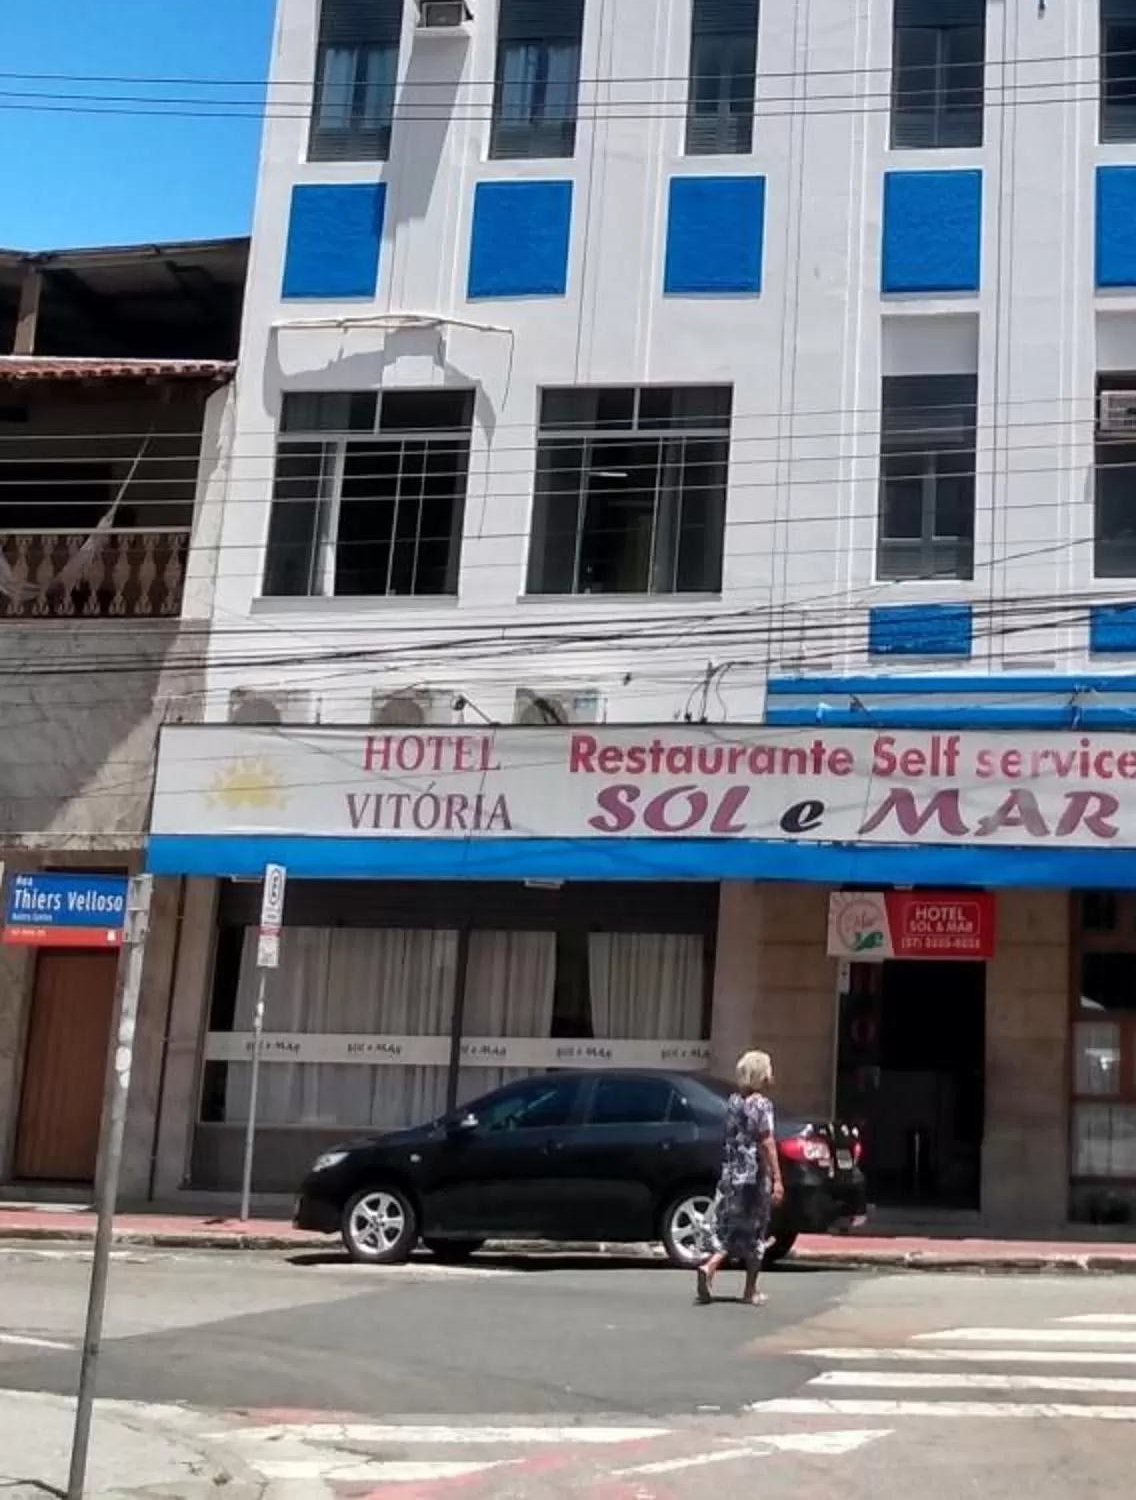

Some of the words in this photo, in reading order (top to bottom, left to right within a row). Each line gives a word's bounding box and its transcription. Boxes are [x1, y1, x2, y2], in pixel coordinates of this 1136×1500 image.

[363, 735, 502, 771] HOTEL
[569, 734, 853, 775] Restaurante
[872, 735, 960, 777] Self
[346, 780, 513, 830] VITÓRIA
[587, 784, 750, 833] SOL
[780, 800, 824, 834] e
[858, 787, 1119, 838] MAR
[14, 887, 61, 910] Thiers
[67, 889, 124, 912] Velloso
[915, 906, 966, 920] HOTEL
[909, 920, 933, 932] SOL
[946, 921, 973, 933] MAR
